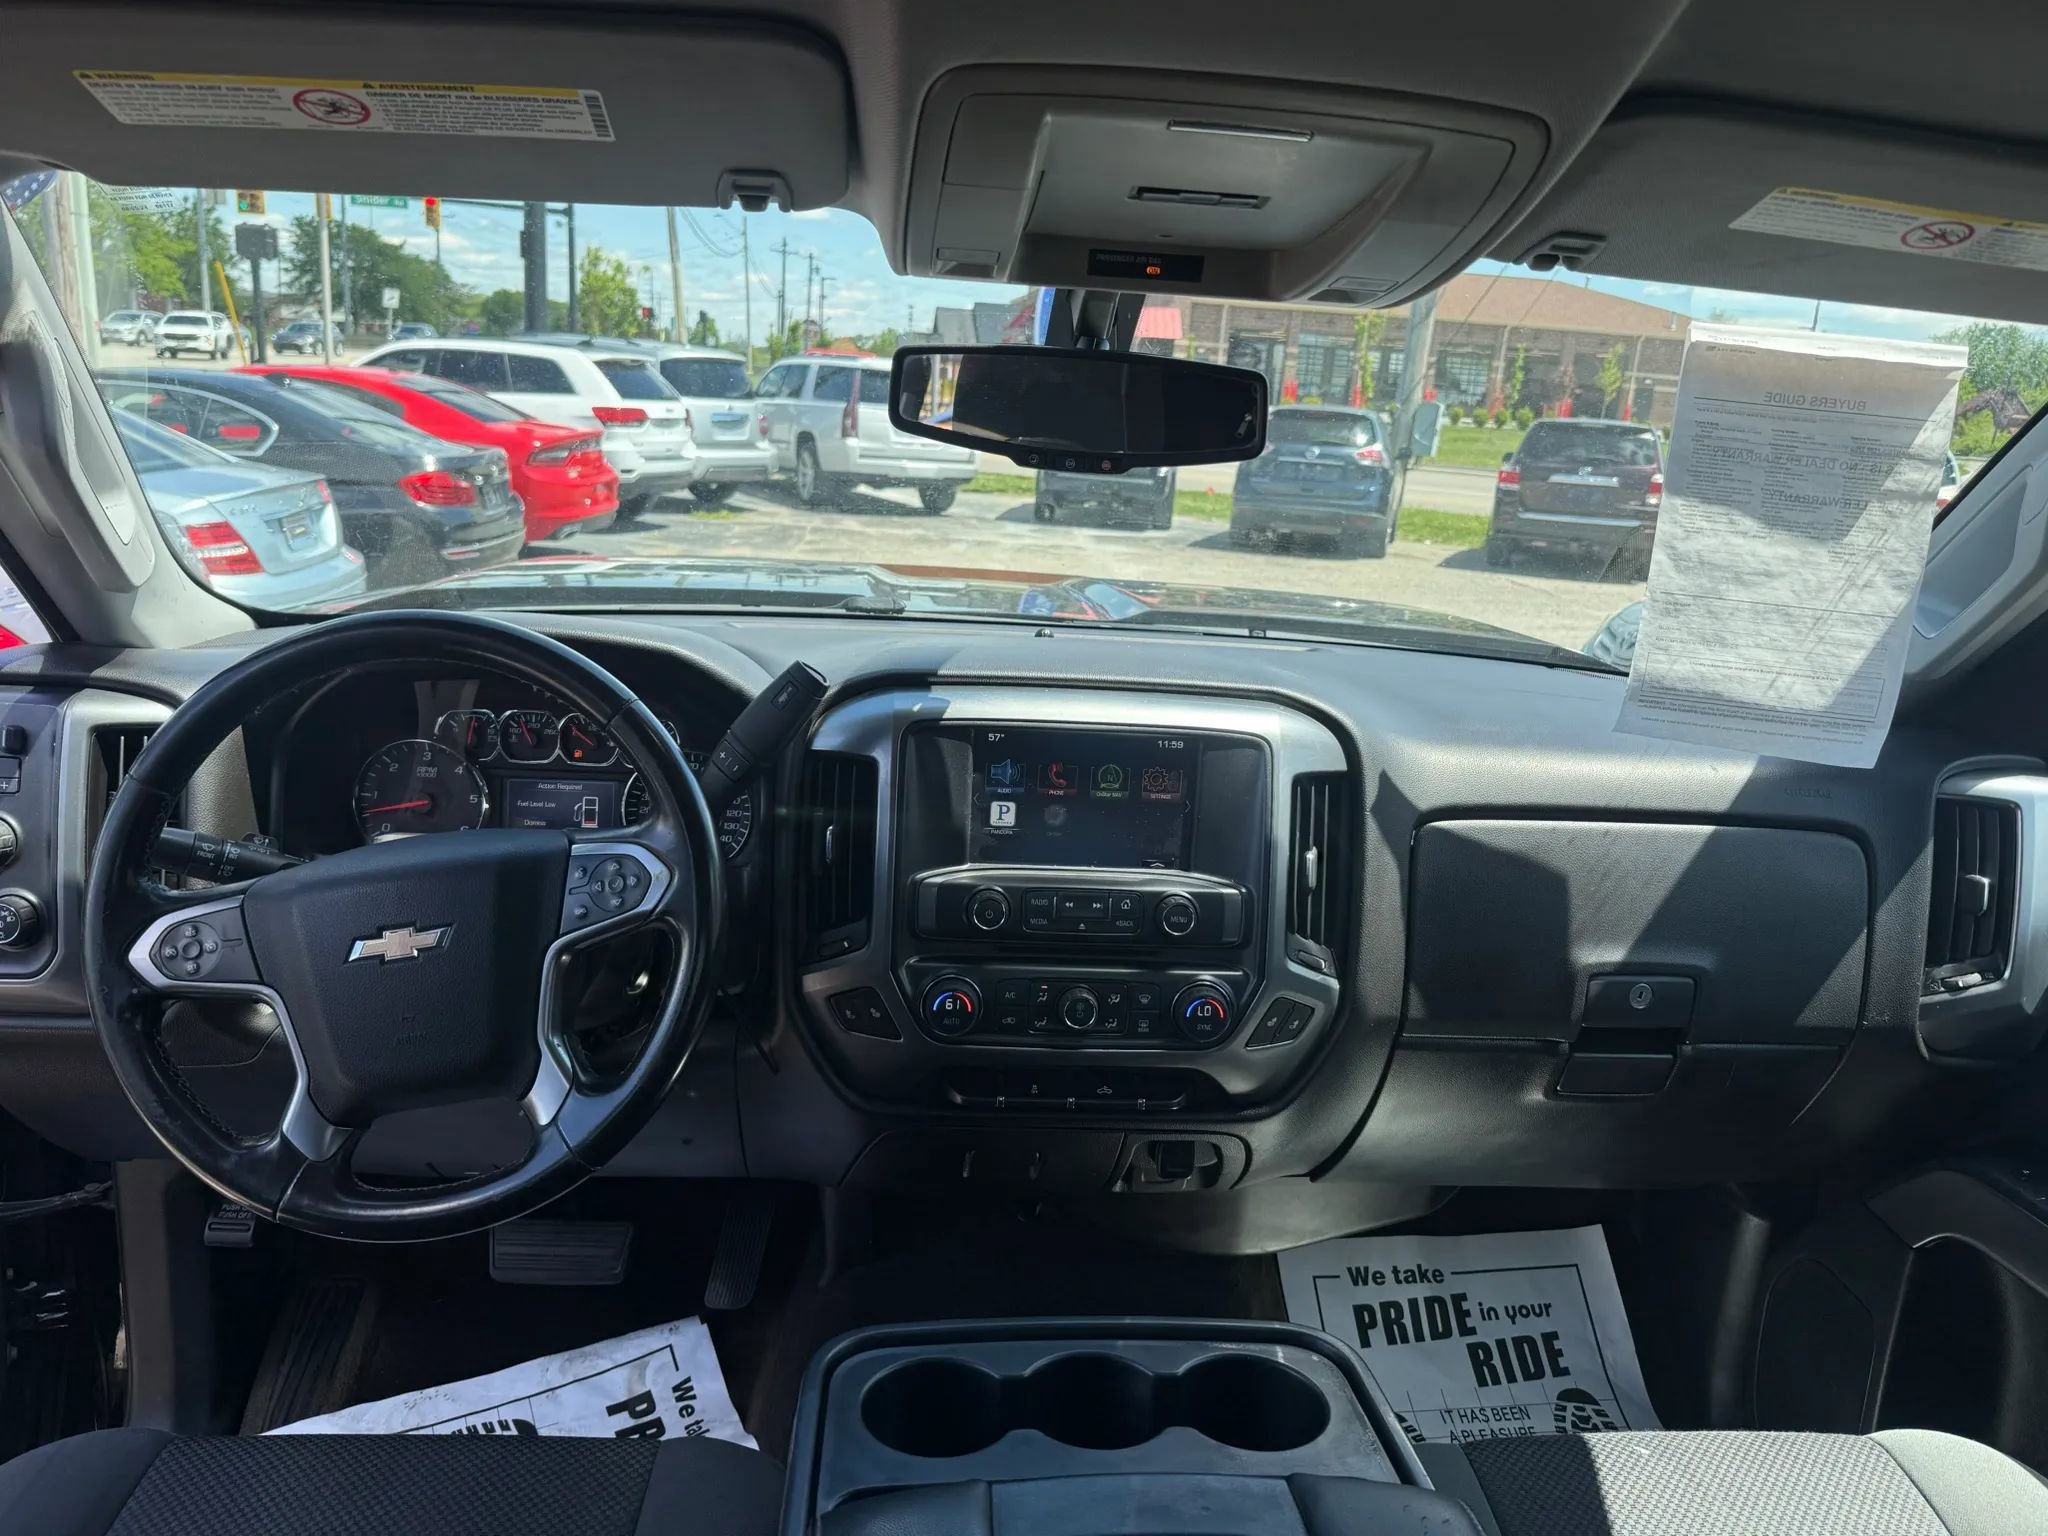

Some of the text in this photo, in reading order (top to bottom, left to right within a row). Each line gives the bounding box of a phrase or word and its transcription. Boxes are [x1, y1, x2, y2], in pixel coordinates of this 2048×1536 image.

[1157, 739, 1184, 750] 11:59
[423, 752, 431, 761] 3
[389, 763, 398, 772] 2
[416, 766, 438, 774] RPM
[454, 765, 464, 775] 4
[557, 784, 583, 792] Required
[468, 794, 478, 803] 5
[996, 803, 1011, 820] P
[381, 823, 391, 833] 0
[723, 822, 740, 830] 130
[197, 850, 215, 860] FRONT
[1030, 898, 1049, 907] RADIO
[1030, 917, 1048, 926] MEDIA
[1170, 915, 1188, 924] MENU
[1005, 990, 1016, 1000] A/C
[943, 1017, 961, 1026] AUTO
[1196, 1023, 1213, 1032] SYNC
[1347, 1264, 1445, 1287] We take
[1353, 1292, 1553, 1349] PRIDE in your
[1467, 1331, 1571, 1388] RIDE
[672, 1376, 697, 1419] We
[1440, 1405, 1531, 1425] IT HAS BEEN
